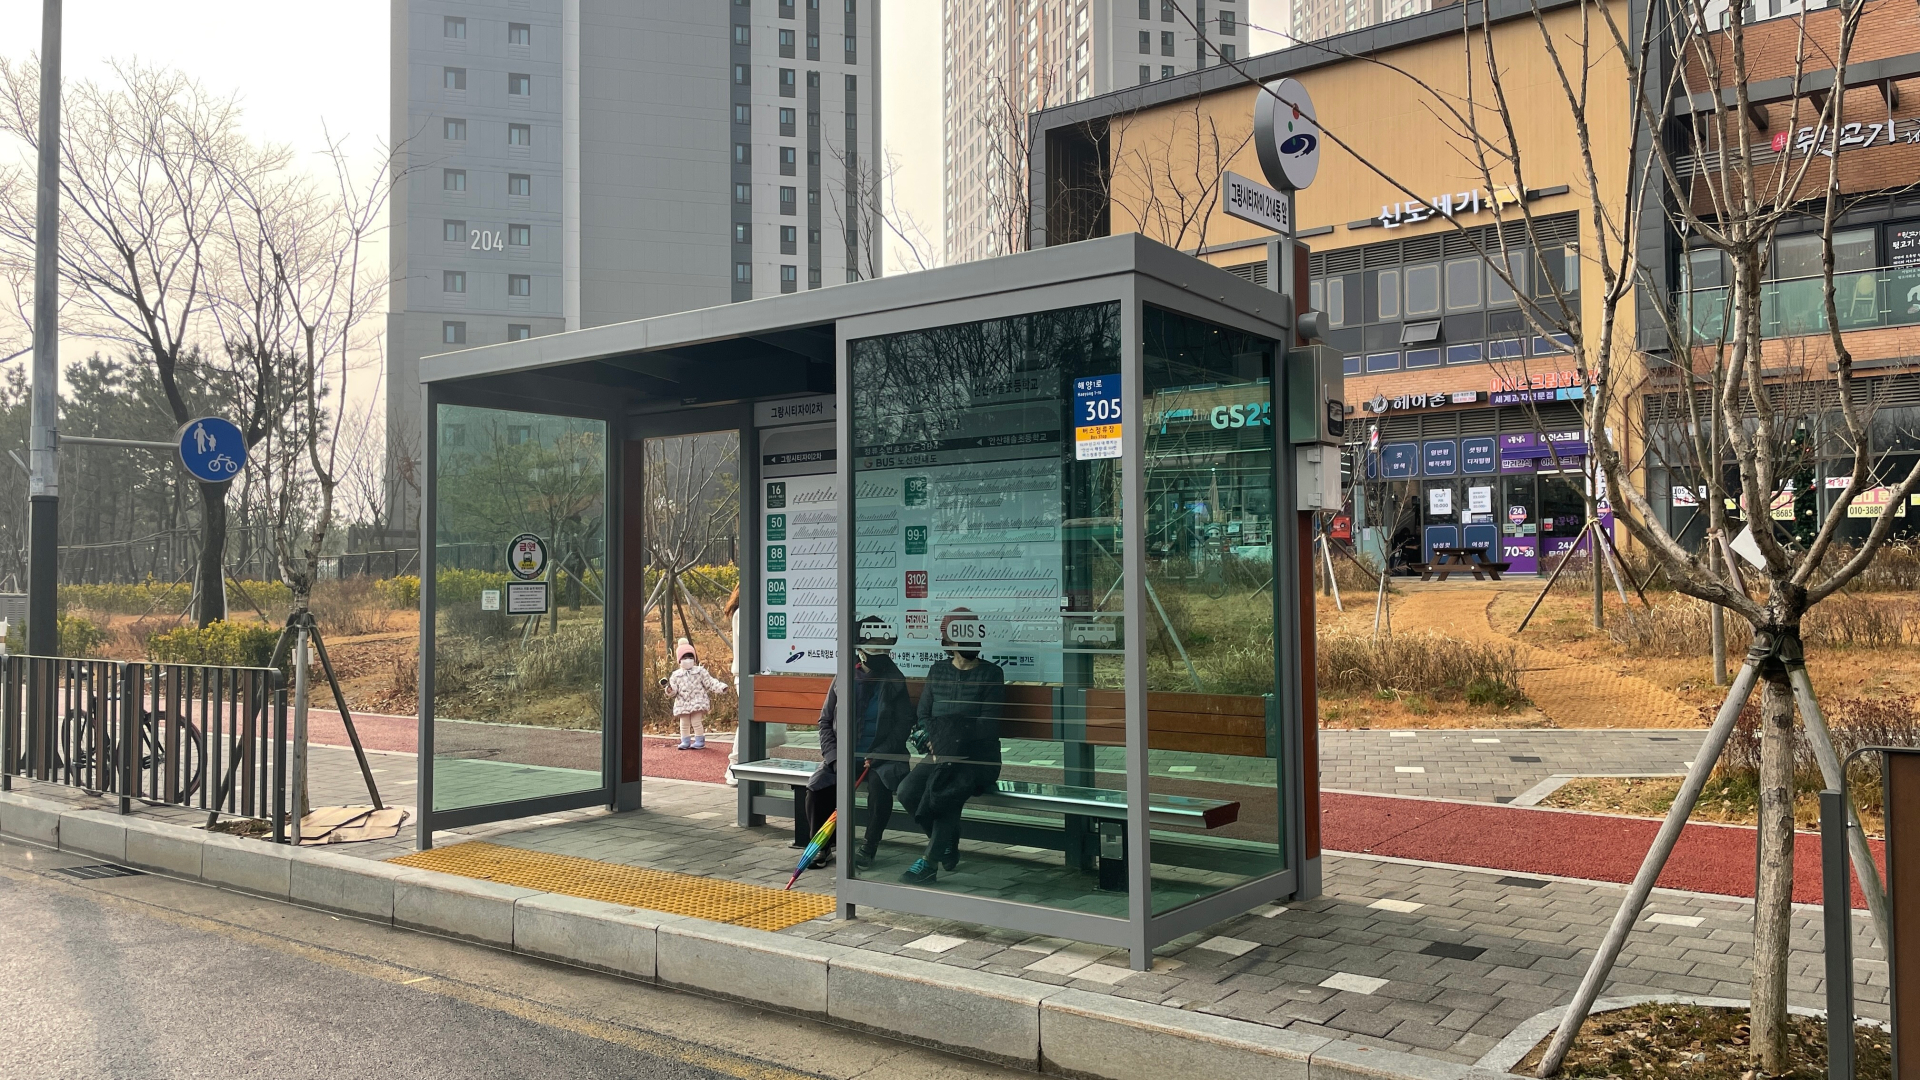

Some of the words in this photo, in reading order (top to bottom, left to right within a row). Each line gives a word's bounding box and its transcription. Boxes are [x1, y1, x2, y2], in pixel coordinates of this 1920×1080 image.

[1231, 183, 1265, 217] 그랑시티자이
[1266, 195, 1281, 223] 214동
[1378, 188, 1480, 230] 신도세기
[470, 229, 504, 252] 204
[1077, 379, 1102, 390] 해양1로
[1393, 391, 1446, 410] 헤어존
[770, 402, 823, 419] 그랑시티자이2차
[1085, 398, 1121, 421] 305
[1210, 401, 1271, 430] GS25
[1082, 426, 1115, 435] 버스정류장
[780, 451, 822, 464] 그랑시티자이2차
[875, 456, 895, 468] BUS
[897, 454, 938, 467] 노선안내도
[771, 484, 782, 495] 16
[1512, 507, 1523, 515] 24
[771, 516, 783, 528] 50
[907, 528, 927, 541] 99-1
[519, 542, 536, 552] 금연
[770, 547, 783, 559] 88
[907, 573, 927, 585] 3102
[768, 581, 786, 593] 80A
[768, 615, 786, 627] 80B
[951, 624, 974, 638] BUS
[1019, 655, 1035, 663] 경기도
